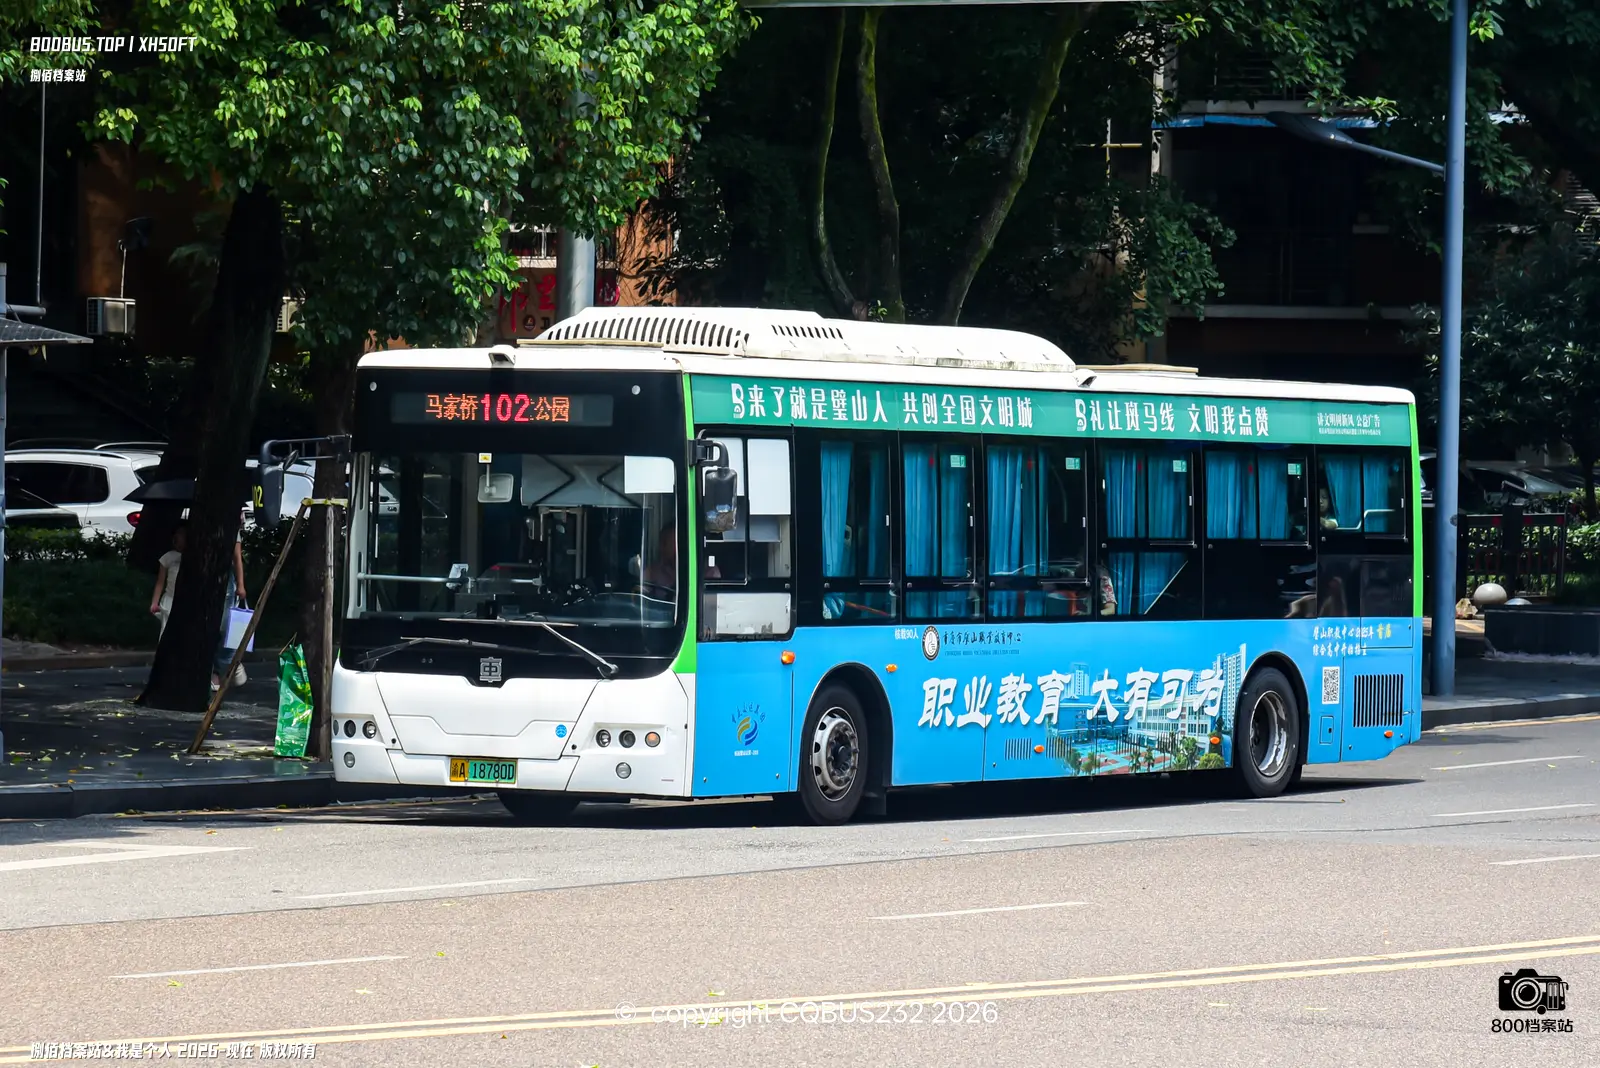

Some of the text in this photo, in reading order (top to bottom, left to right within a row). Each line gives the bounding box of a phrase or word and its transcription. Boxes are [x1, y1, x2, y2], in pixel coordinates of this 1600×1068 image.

[426, 393, 570, 422] 马家桥 102 公园
[748, 384, 1033, 428] 来了就是璧山人 共创全国文明城
[1090, 400, 1269, 436] 礼让斑马线 文明我点赞
[918, 666, 1225, 729] 职业教育 大有可为
